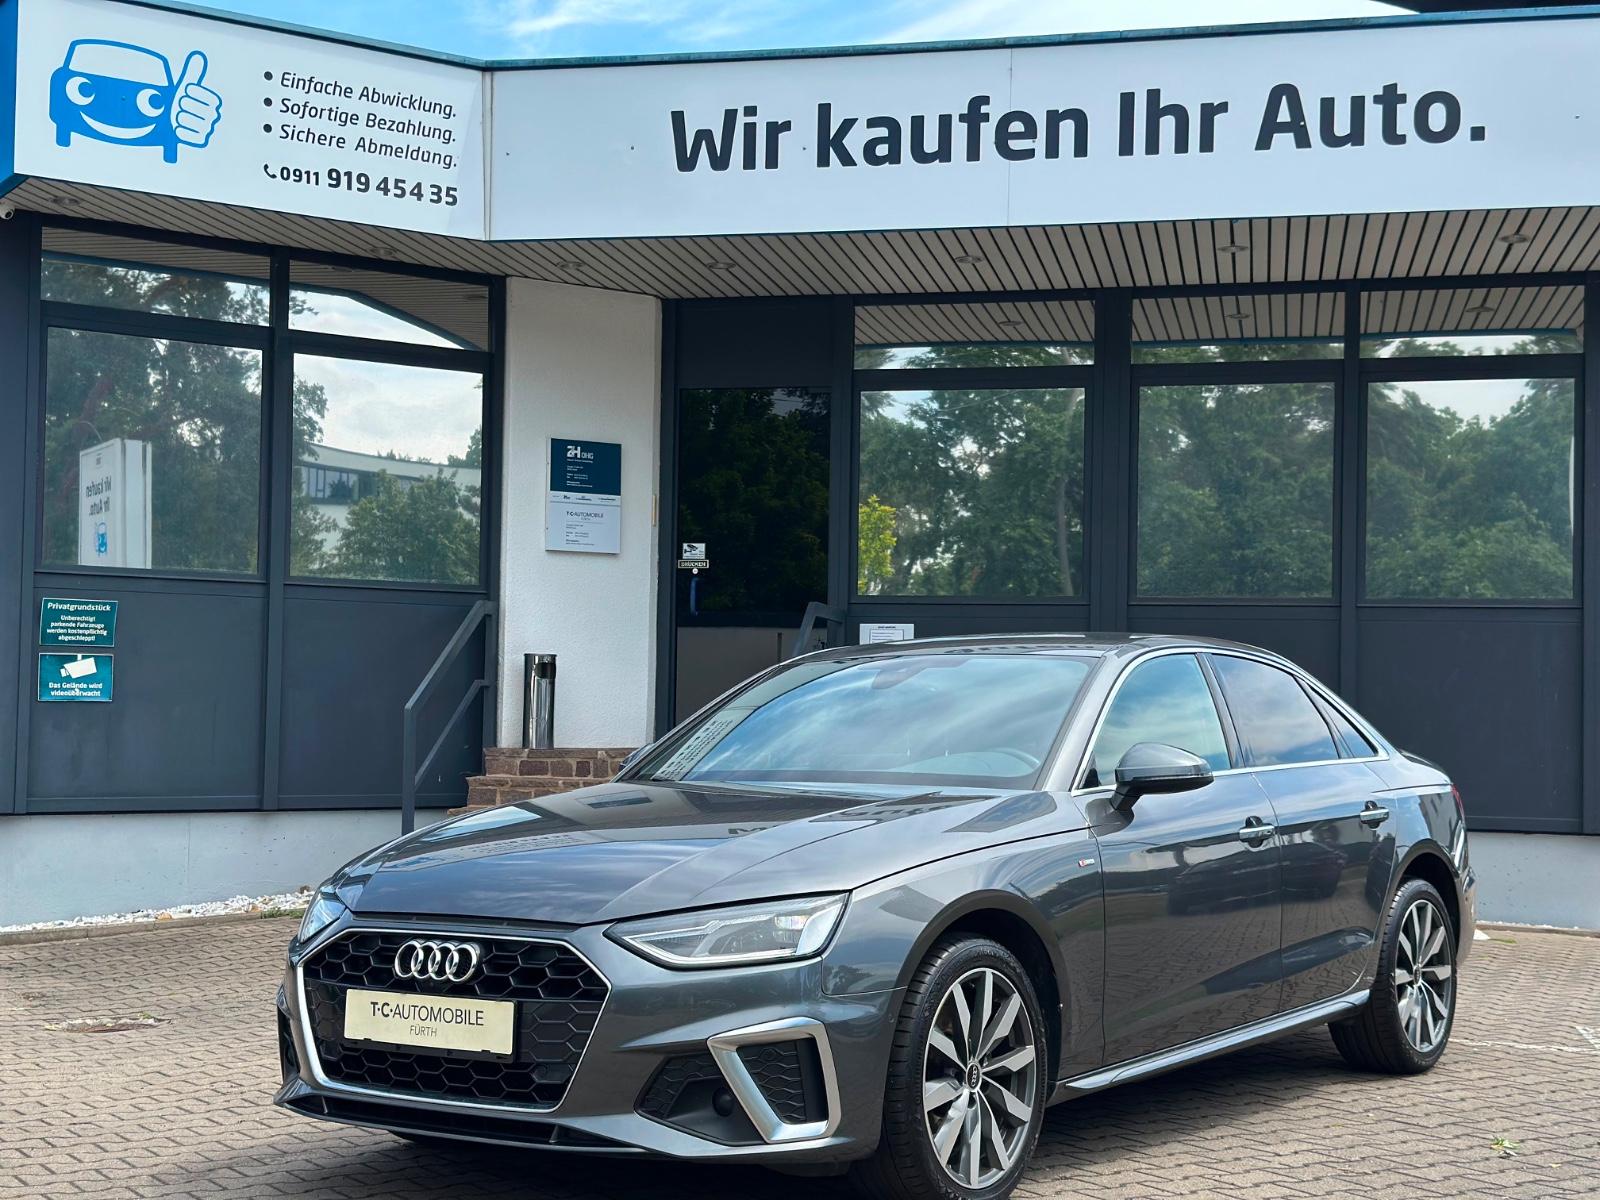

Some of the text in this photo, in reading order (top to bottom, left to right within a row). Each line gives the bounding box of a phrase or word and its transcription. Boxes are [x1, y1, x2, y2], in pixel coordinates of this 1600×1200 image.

[280, 71, 457, 120] Einfache Abwicklung.
[279, 97, 457, 145] Sofortige Bezahlung.
[671, 82, 1486, 172] Wir kaufen Ihr Auto.
[279, 123, 458, 170] Sichere Abmeldung.
[279, 166, 320, 186] 0911
[47, 602, 111, 612] Privatgrundstück
[68, 628, 107, 636] kostenpflichtig
[77, 622, 104, 630] Fahrzeuge
[50, 689, 101, 697] videoüberwacht
[409, 1024, 438, 1037] FÜRTH
